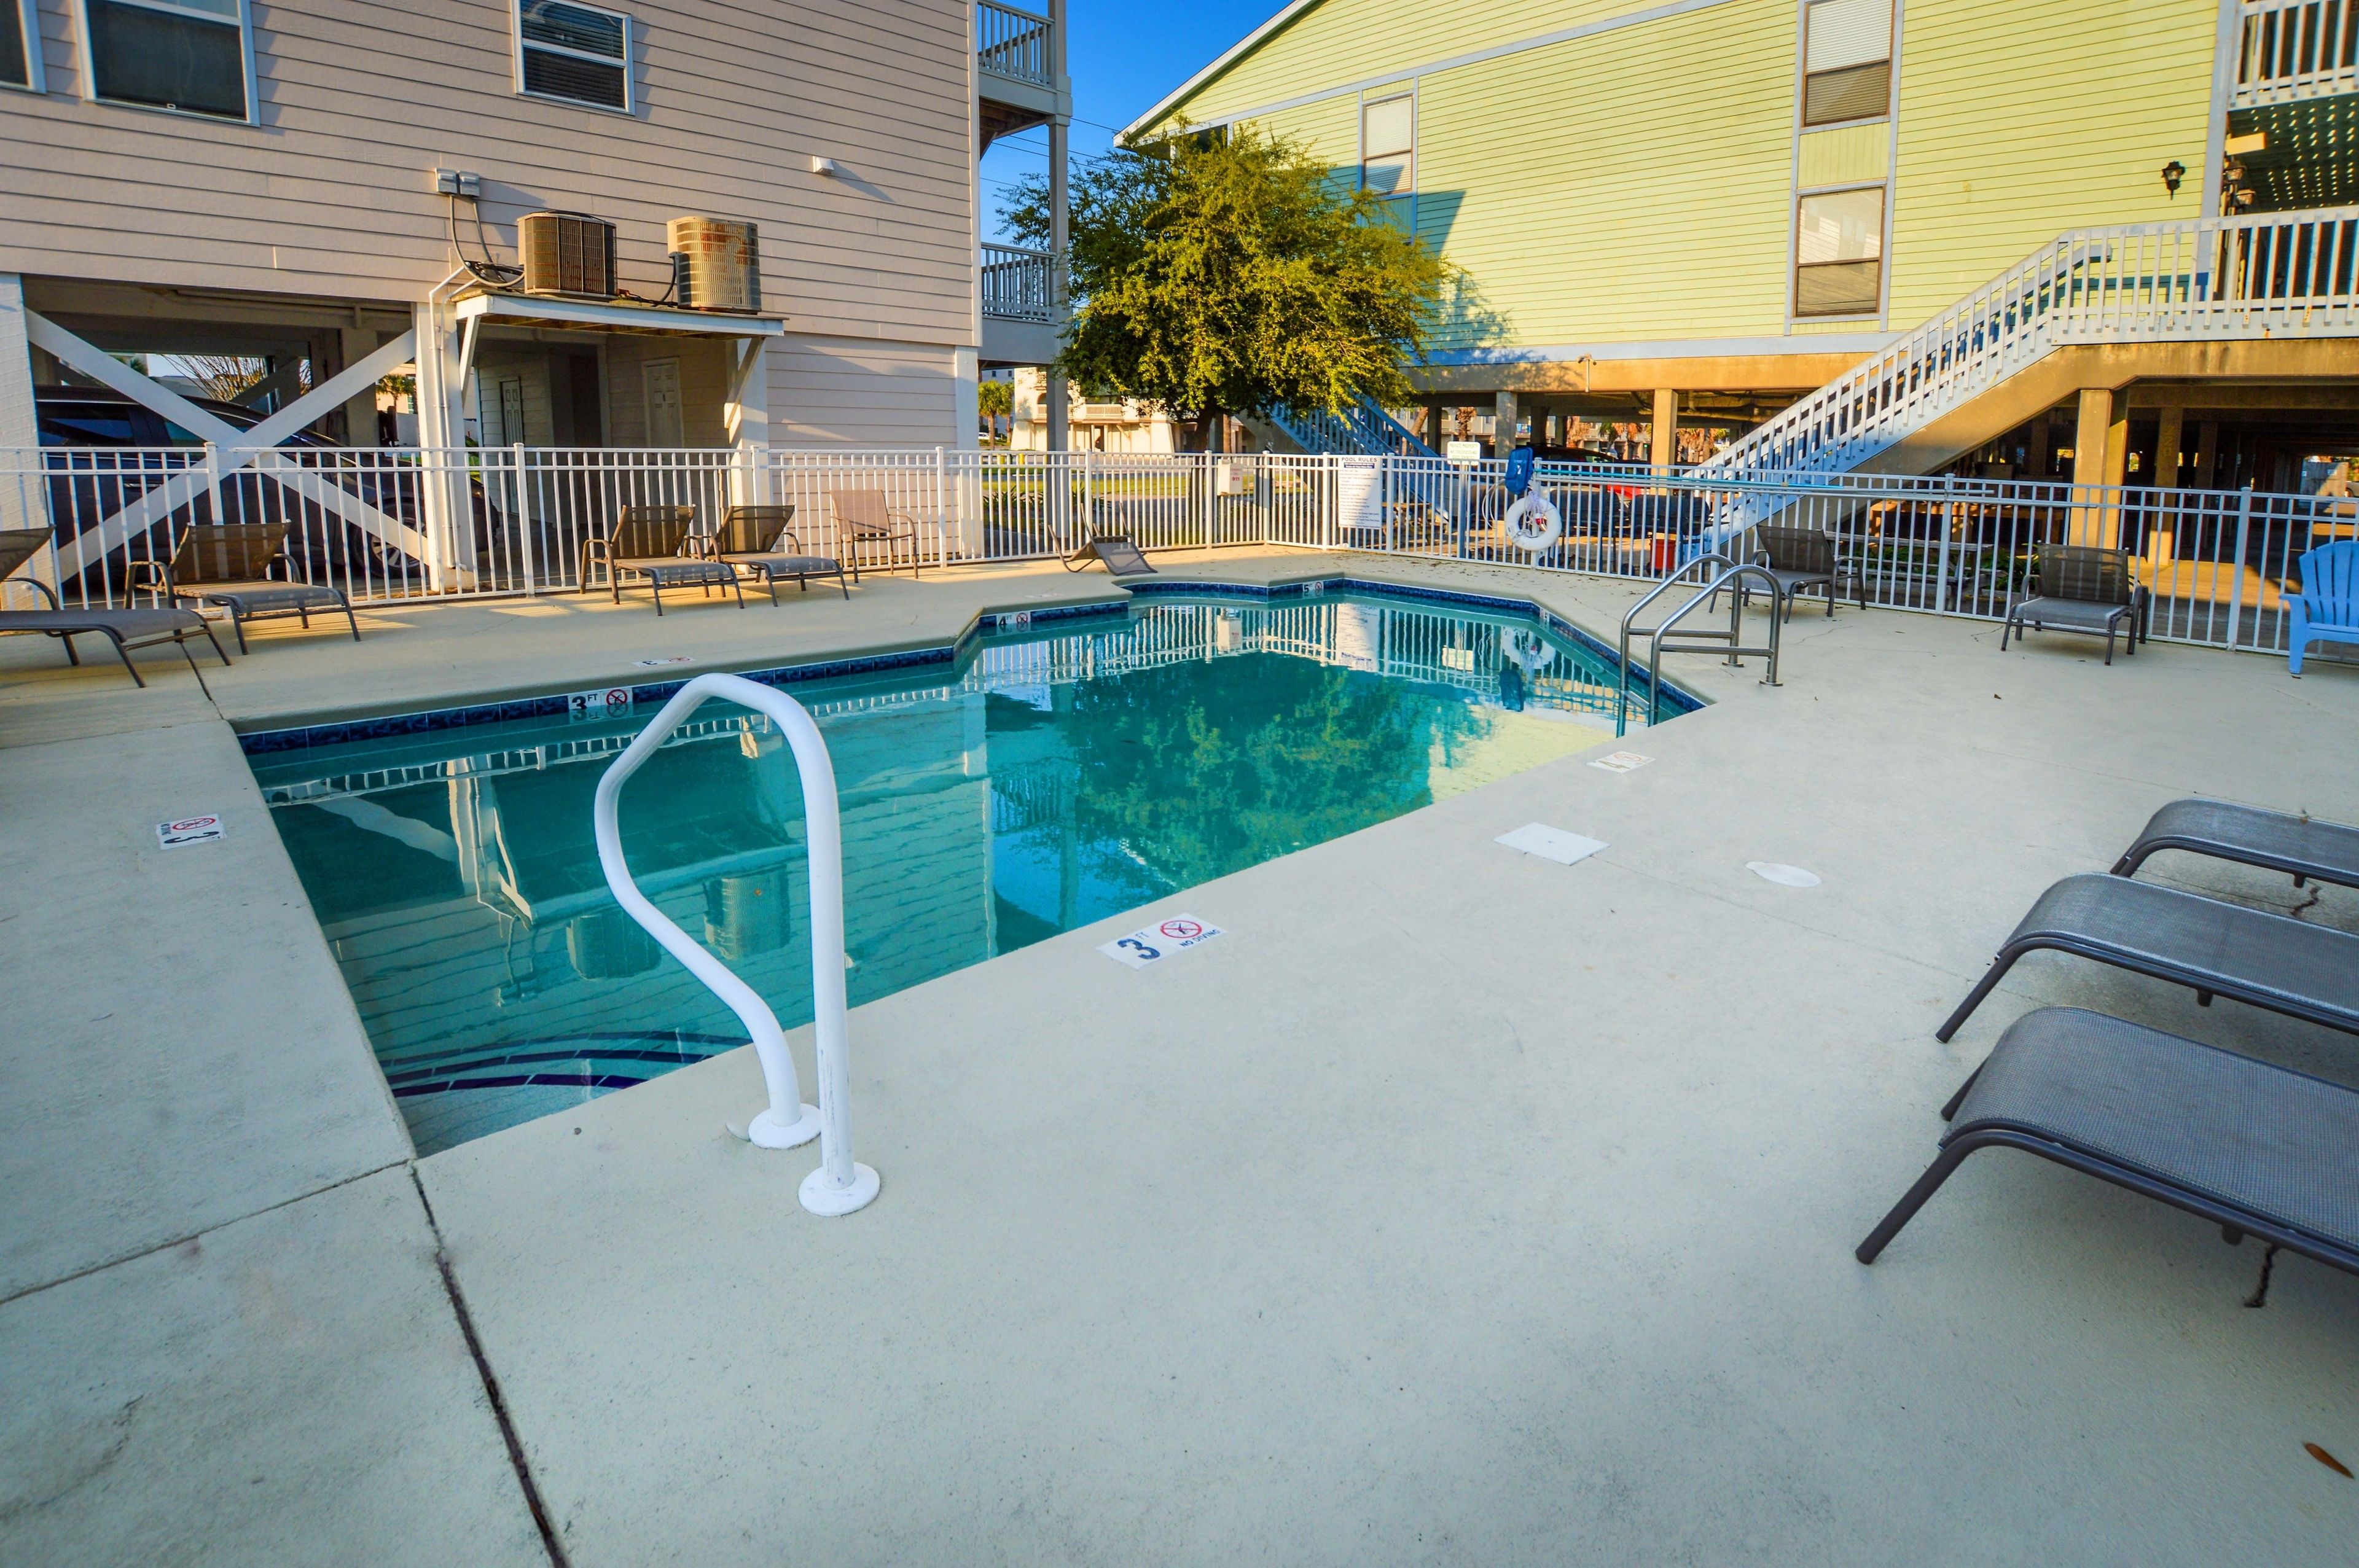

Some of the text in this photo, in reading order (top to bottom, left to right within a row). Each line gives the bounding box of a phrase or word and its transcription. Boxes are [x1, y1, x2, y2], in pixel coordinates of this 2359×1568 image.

[1304, 584, 1309, 593] 5
[998, 615, 1007, 625] 4
[571, 695, 587, 711] 3
[163, 831, 220, 844] 3
[1192, 929, 1221, 942] DIVING
[1117, 938, 1160, 960] 3
